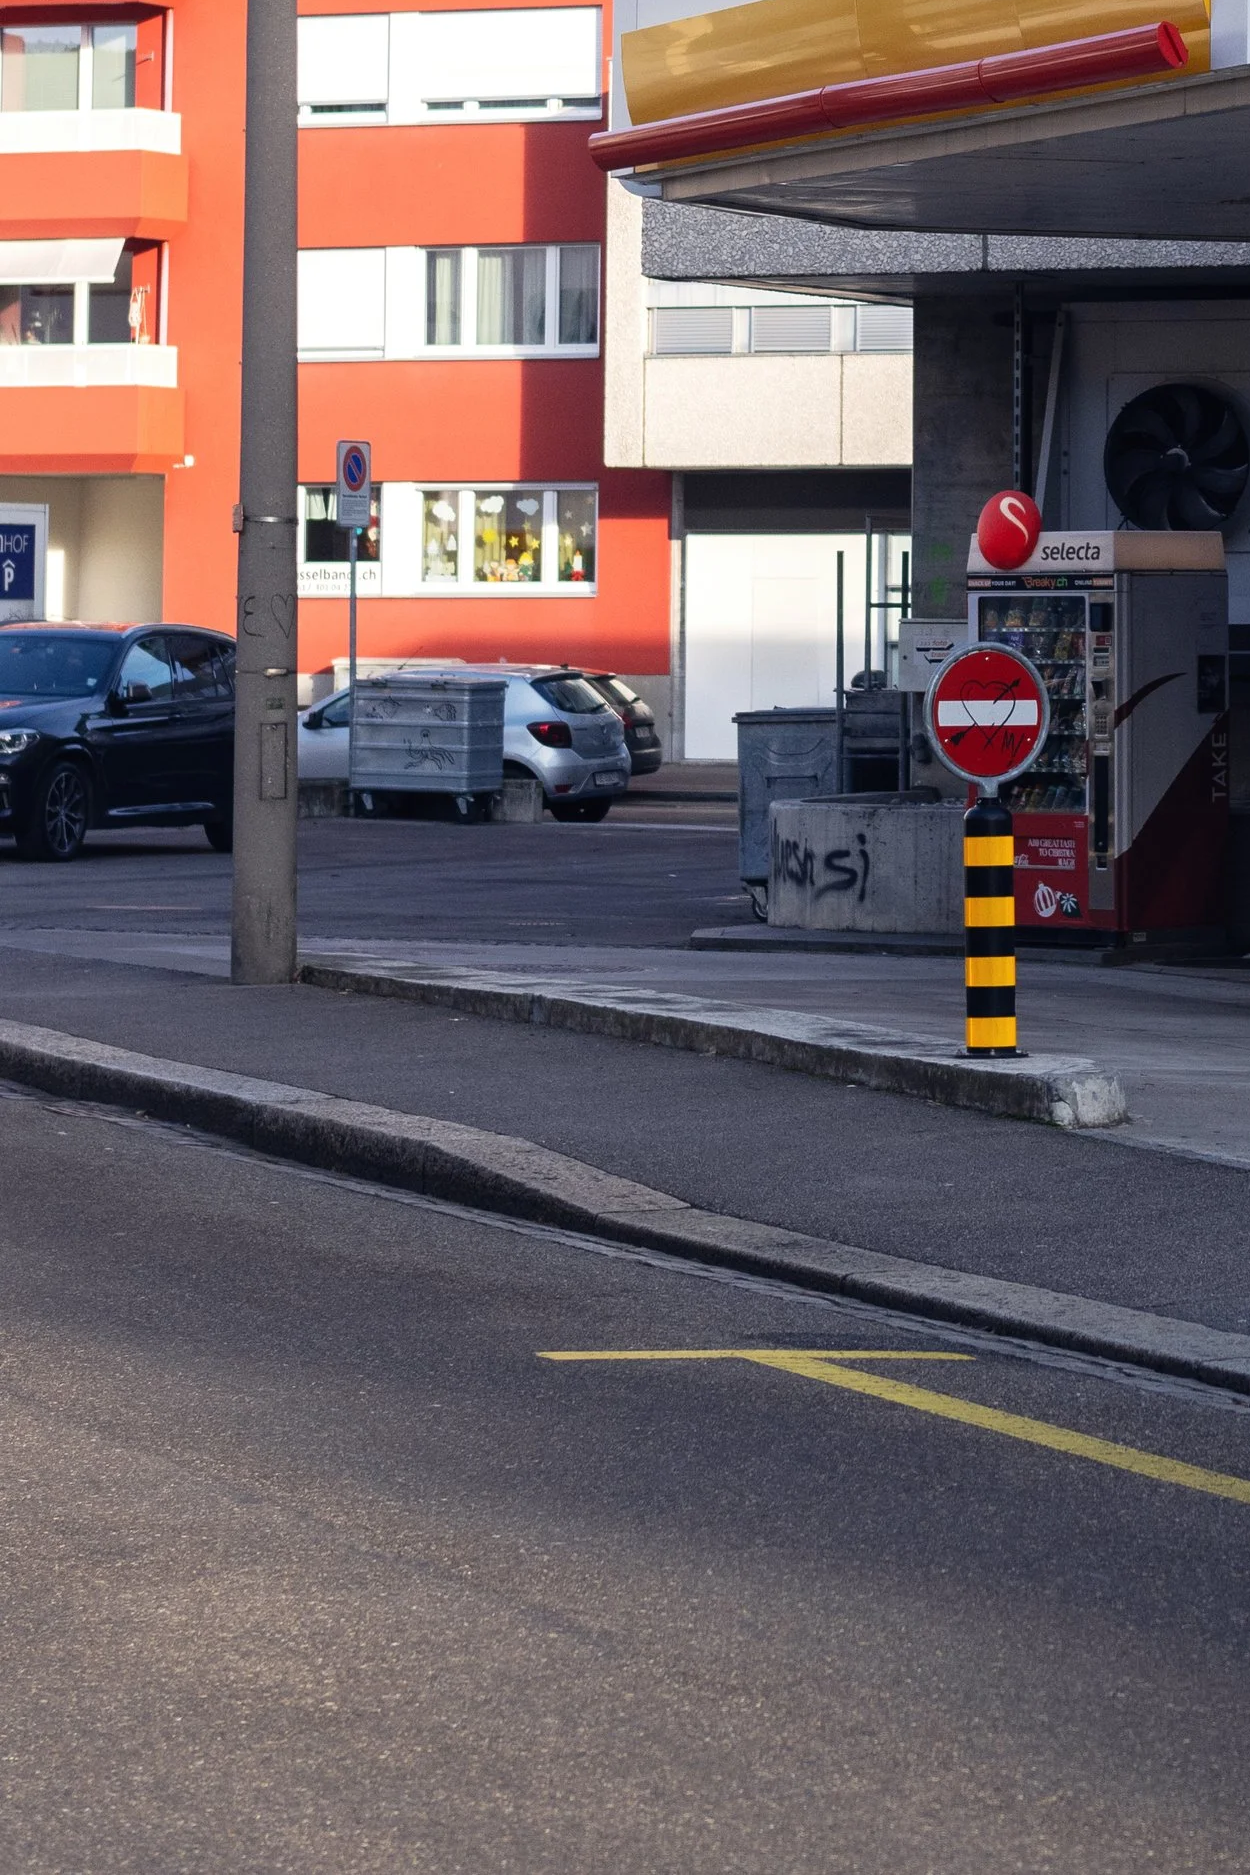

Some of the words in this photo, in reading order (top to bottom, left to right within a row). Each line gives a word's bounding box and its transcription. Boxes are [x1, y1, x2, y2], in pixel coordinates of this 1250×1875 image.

[1041, 542, 1100, 560] selecta
[1212, 737, 1227, 803] TAKE
[1039, 848, 1048, 857] TO
